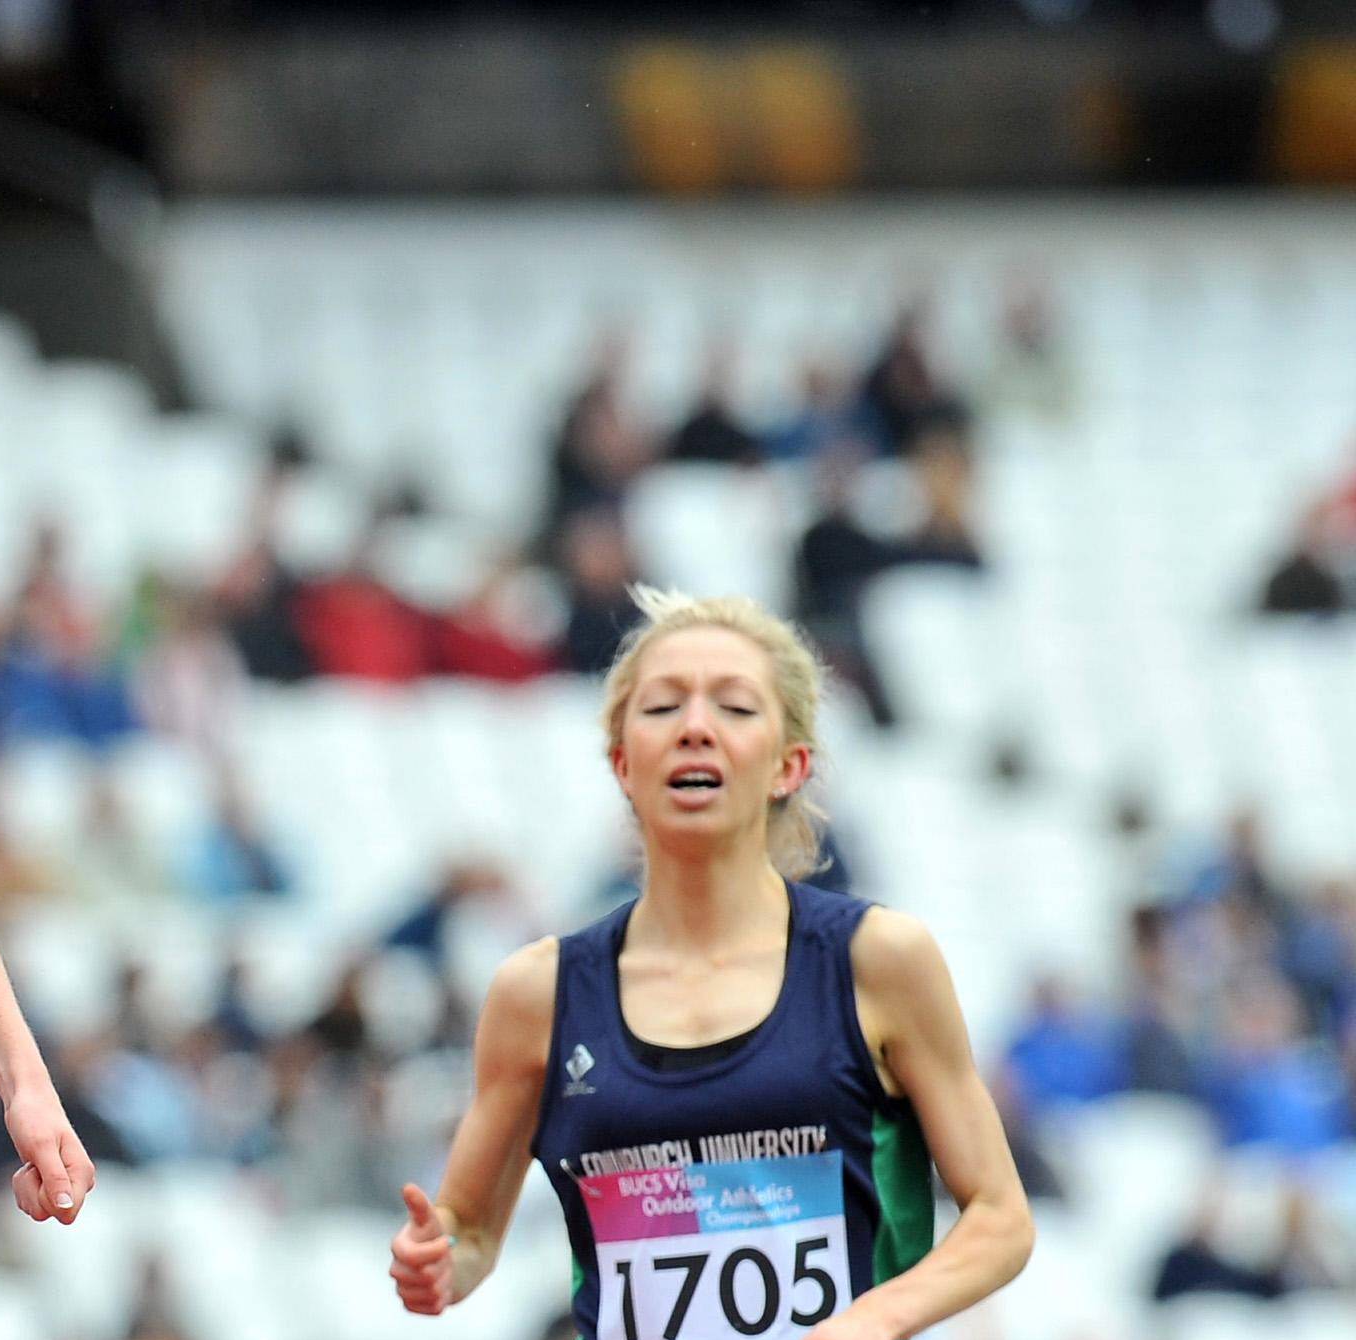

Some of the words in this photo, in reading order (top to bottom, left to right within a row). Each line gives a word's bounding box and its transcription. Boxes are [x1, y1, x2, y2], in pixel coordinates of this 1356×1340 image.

[698, 1126, 827, 1165] UNIVERSITY
[617, 1173, 663, 1197] BUCS
[663, 1171, 708, 1191] Visa
[641, 1193, 714, 1217] Outdoor
